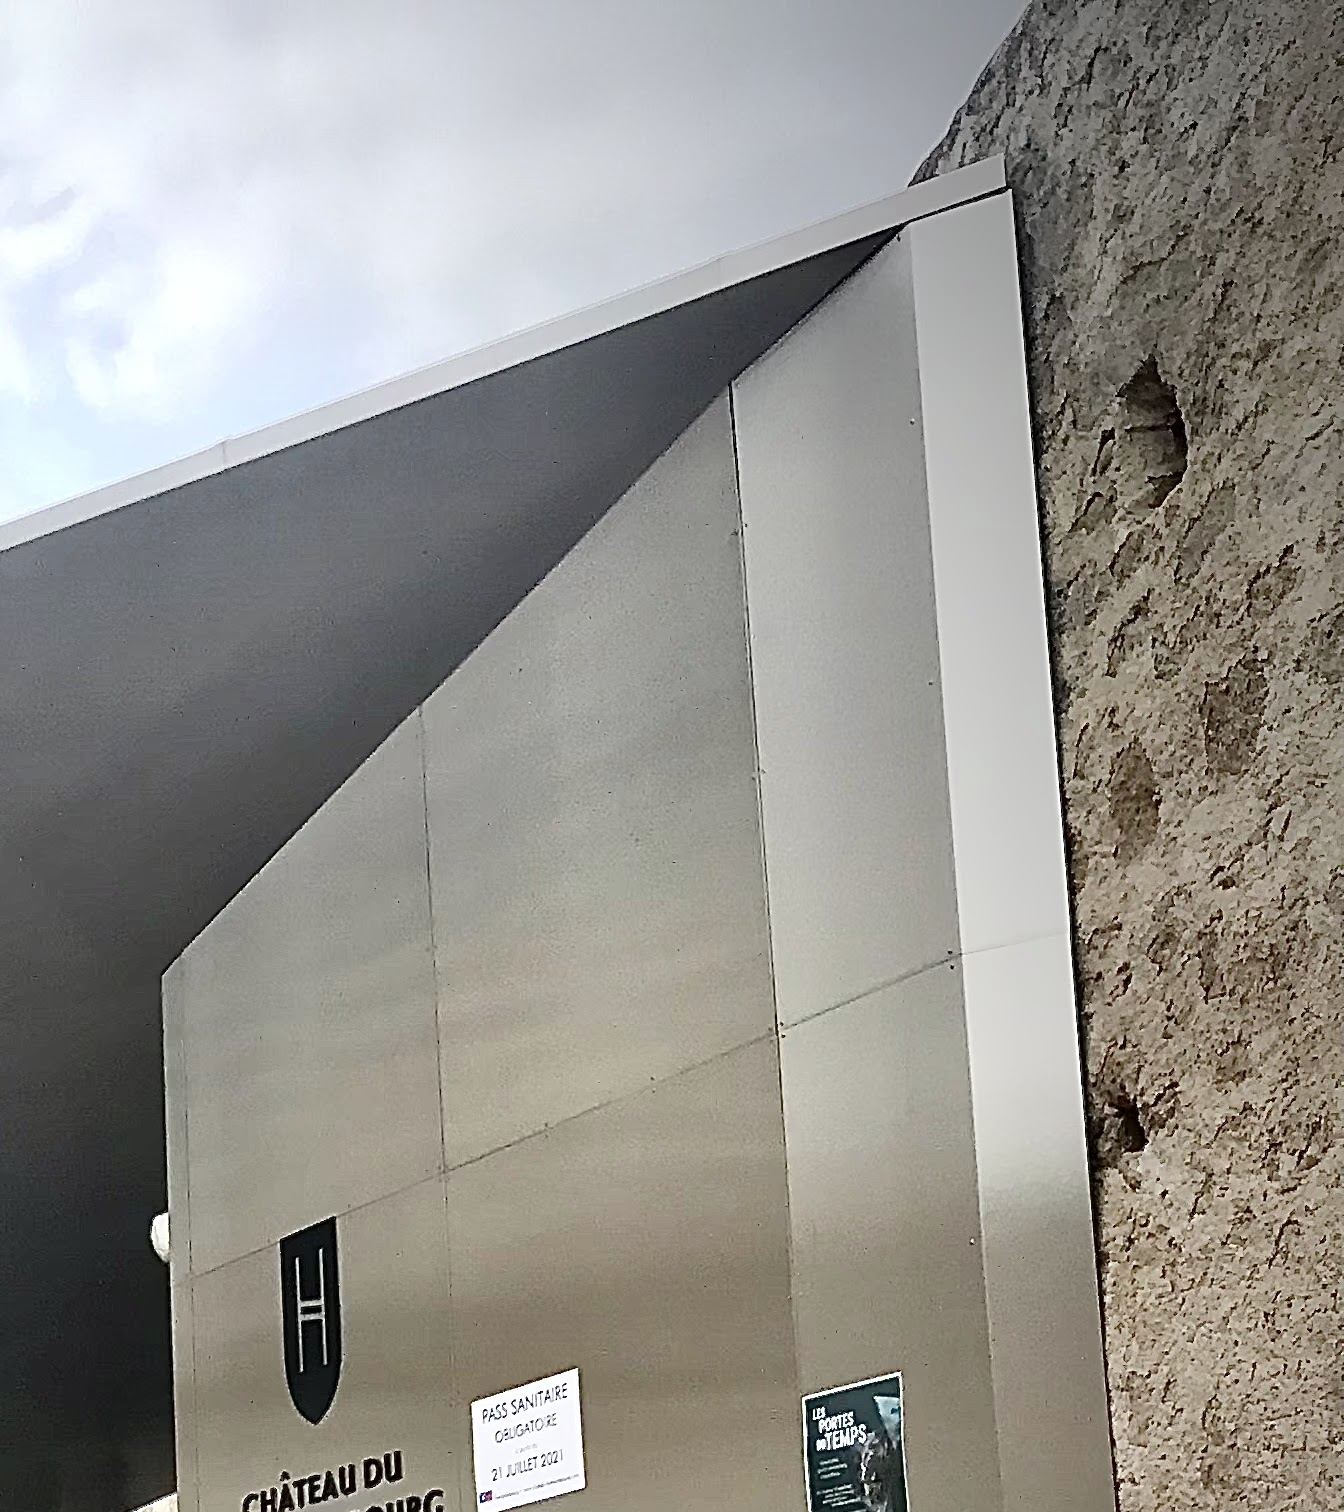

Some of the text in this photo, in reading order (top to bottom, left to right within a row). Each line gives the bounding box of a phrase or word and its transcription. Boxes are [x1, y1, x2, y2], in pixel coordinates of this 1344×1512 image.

[482, 1382, 568, 1424] PASS SANITAIRE
[812, 1406, 826, 1420] LES
[494, 1412, 557, 1443] OBLIGATOIRE
[818, 1411, 854, 1434] PORTES
[824, 1423, 867, 1451] TEMPS
[362, 1450, 404, 1489] DU
[491, 1466, 503, 1482] 21
[506, 1455, 538, 1478] JUILLET
[540, 1448, 564, 1468] 2021
